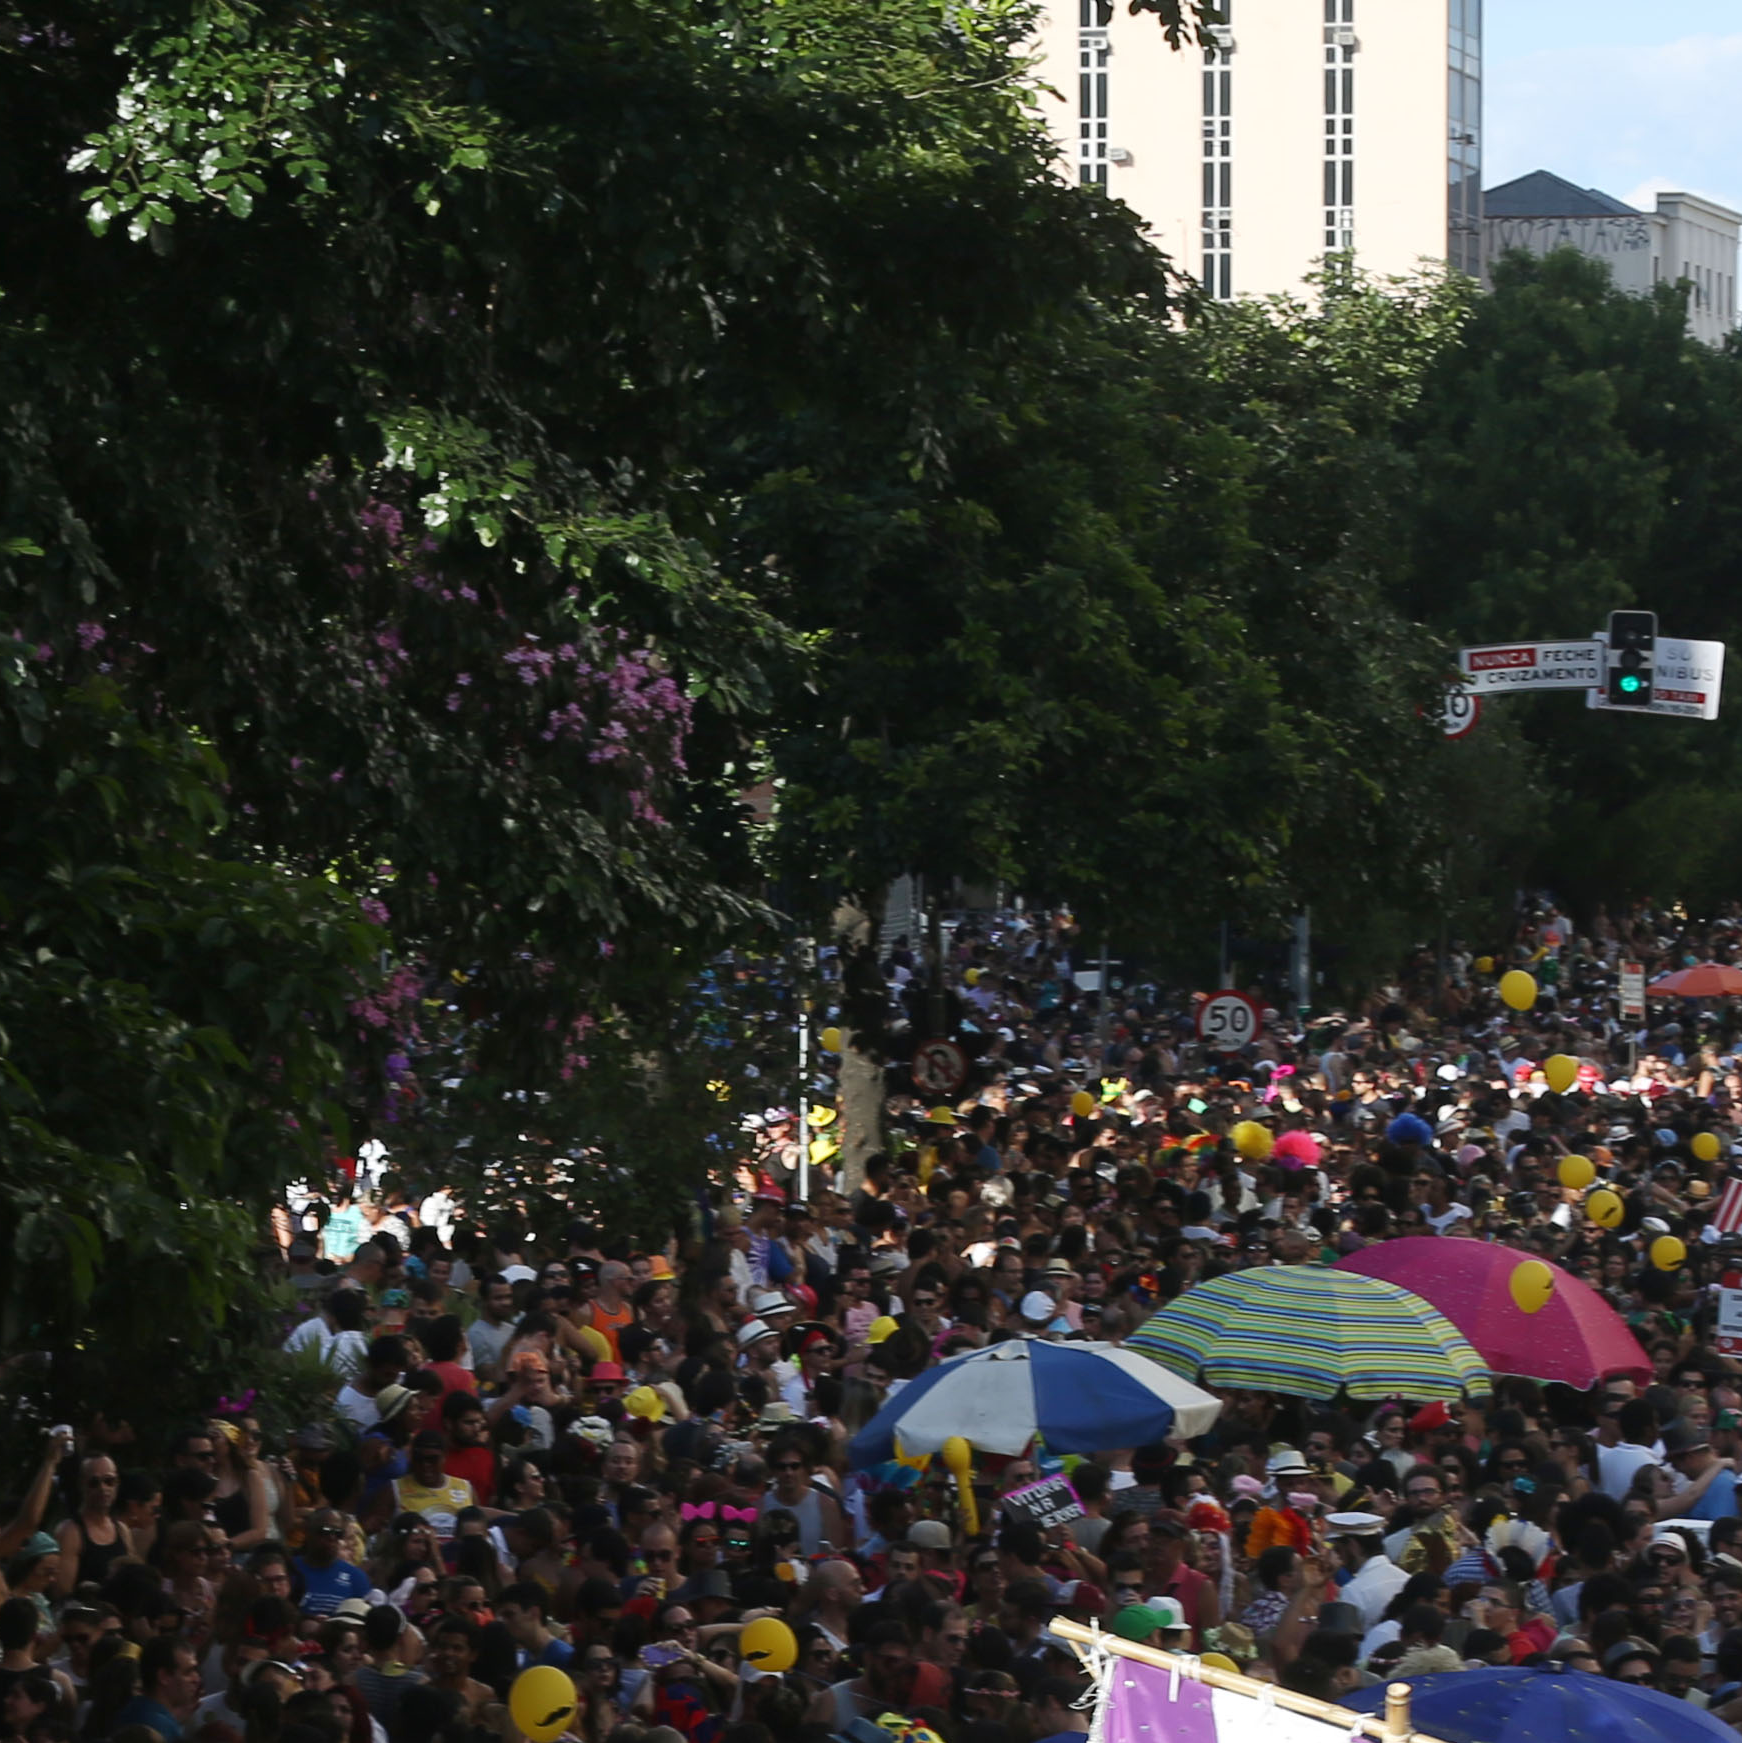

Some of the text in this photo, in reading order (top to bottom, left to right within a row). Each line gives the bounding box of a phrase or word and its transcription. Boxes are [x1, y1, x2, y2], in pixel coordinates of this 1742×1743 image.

[1473, 646, 1596, 669] NUNCA FECHE
[1486, 667, 1598, 685] CRUZAMENTO
[1209, 1005, 1250, 1033] 50
